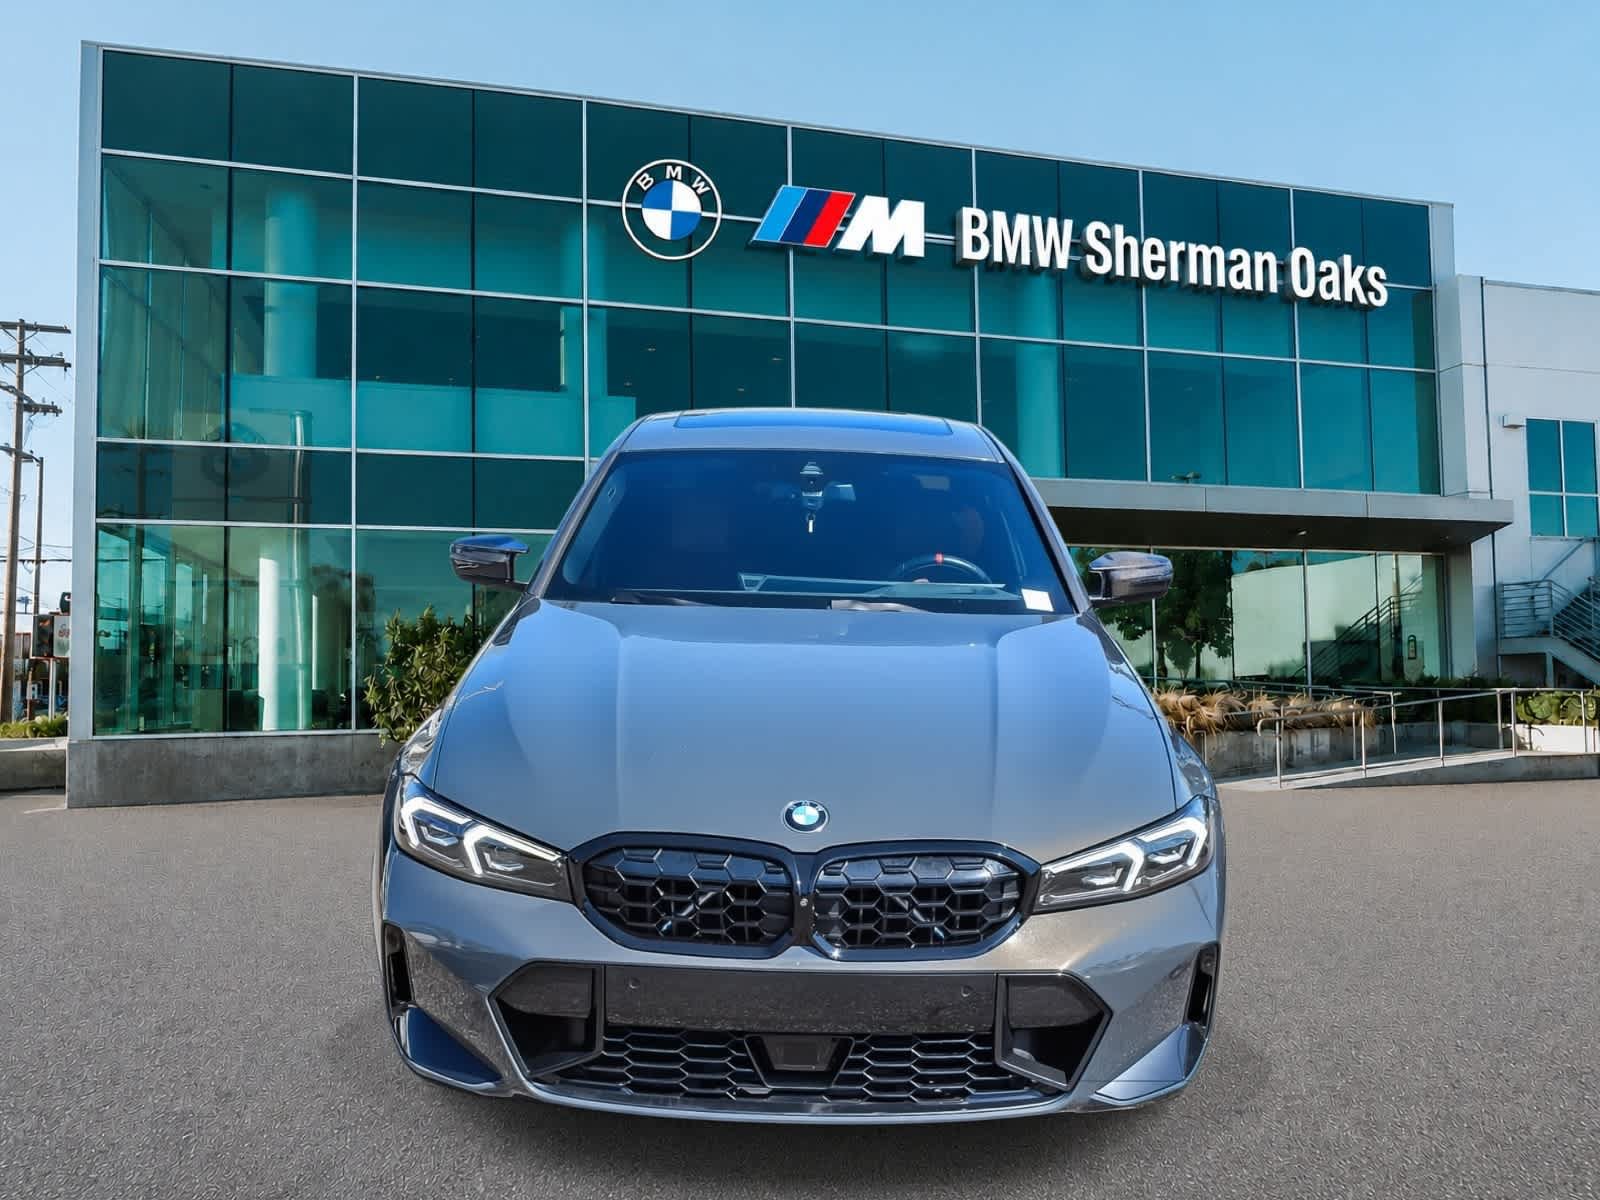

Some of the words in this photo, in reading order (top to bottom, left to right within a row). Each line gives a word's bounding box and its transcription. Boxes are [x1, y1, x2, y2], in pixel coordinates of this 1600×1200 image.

[636, 165, 711, 196] BMW
[836, 195, 925, 258] M
[960, 206, 1073, 270] BMW
[1084, 220, 1278, 294] Sherman
[1290, 247, 1388, 307] Oaks
